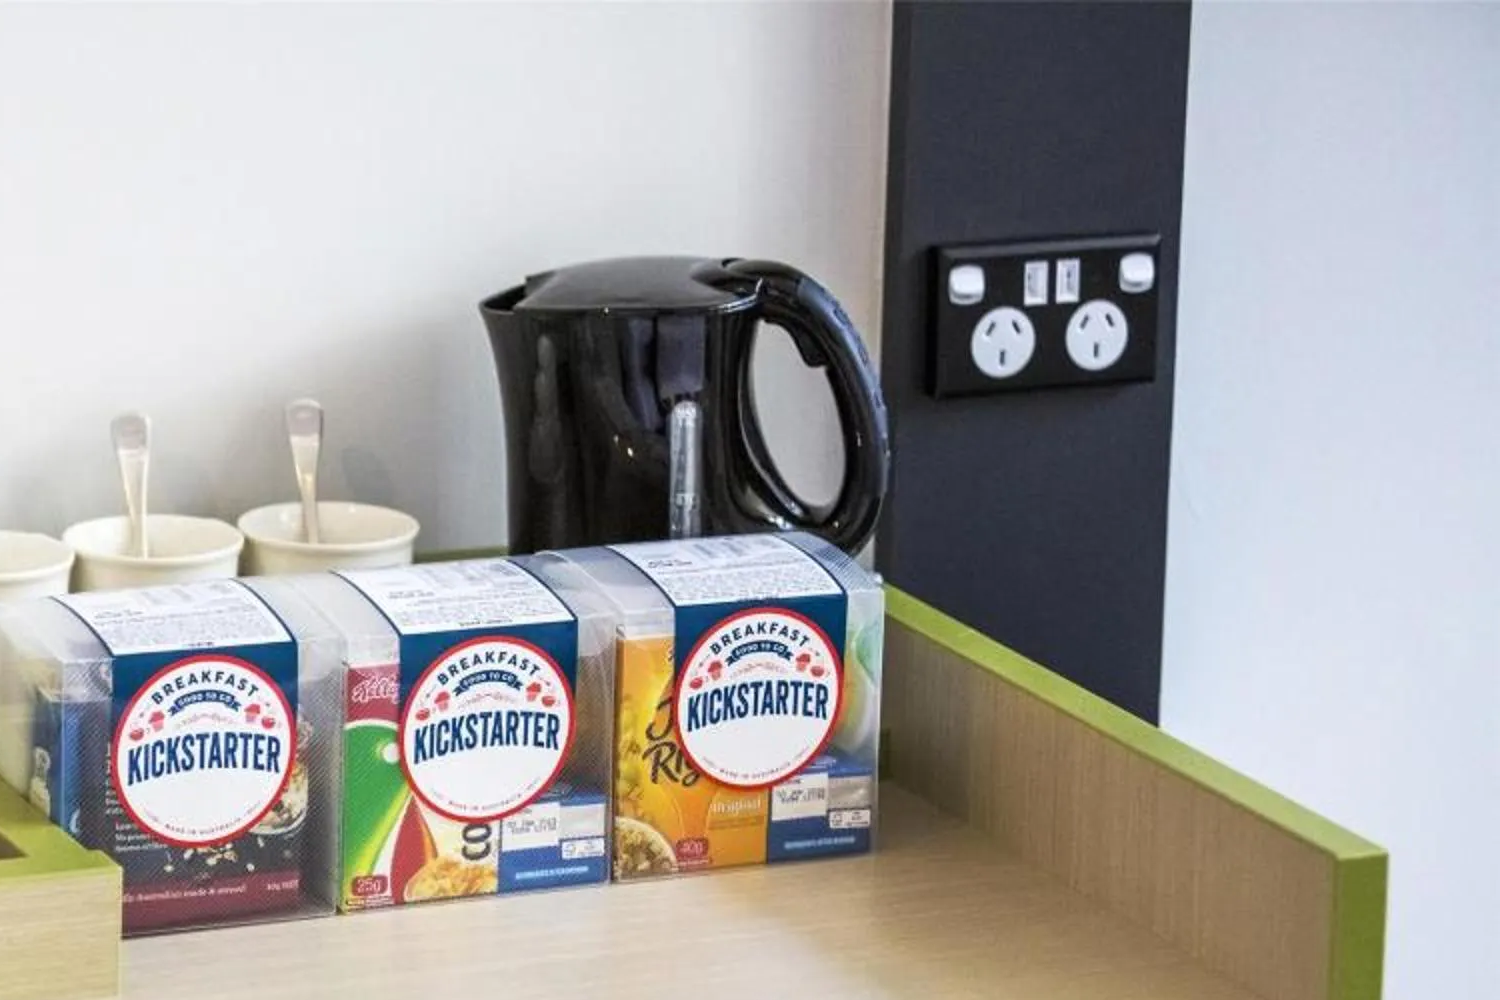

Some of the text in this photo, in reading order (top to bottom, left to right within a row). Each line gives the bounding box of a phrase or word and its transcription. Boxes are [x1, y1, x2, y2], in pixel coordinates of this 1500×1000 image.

[709, 621, 811, 655] BREAKFAST
[151, 670, 259, 705] BREAKFAST
[437, 650, 541, 685] BREAKFAST
[687, 680, 829, 733] KICKSTARTER
[128, 732, 281, 786] KICKSTARTER
[414, 710, 560, 765] KICKSTARTER
